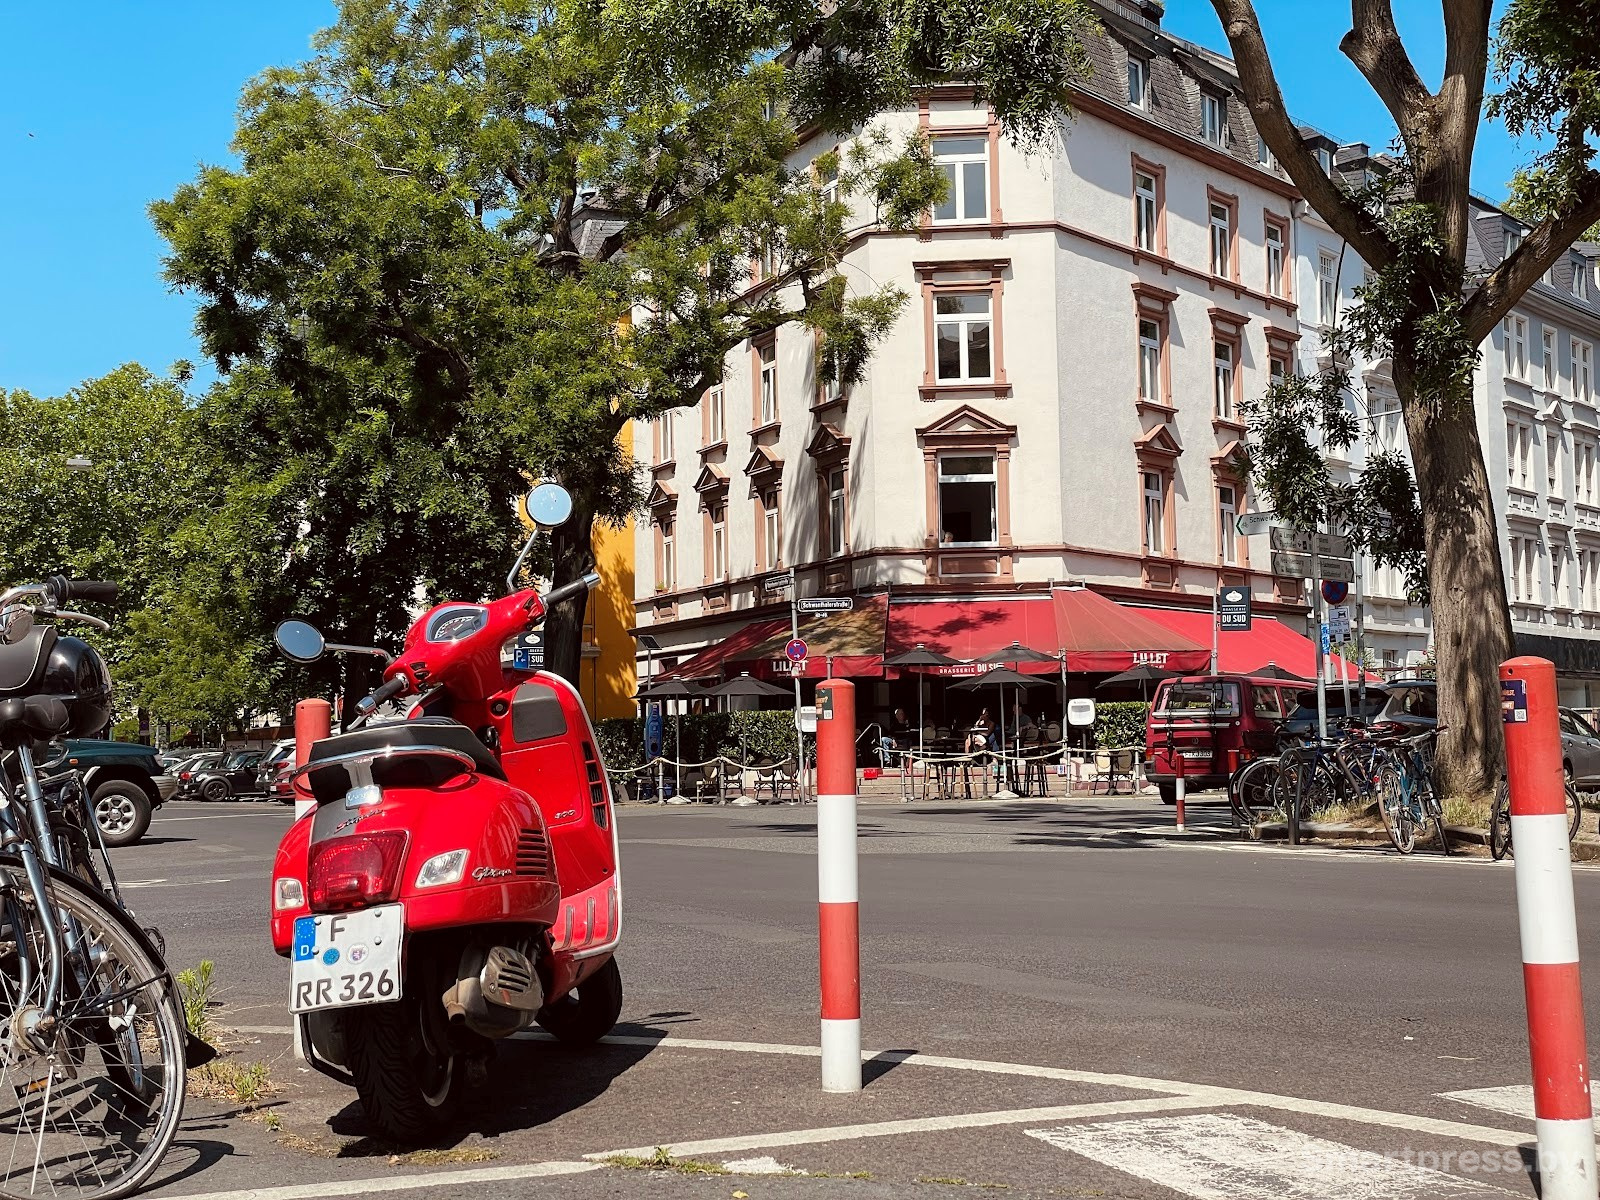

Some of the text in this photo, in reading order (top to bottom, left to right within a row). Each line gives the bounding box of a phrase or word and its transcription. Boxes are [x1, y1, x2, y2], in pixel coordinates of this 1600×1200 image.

[1222, 614, 1247, 623] DU SUD
[515, 650, 523, 662] P
[531, 655, 544, 663] SUD
[1132, 652, 1170, 664] LILLET
[977, 663, 987, 673] DU
[330, 914, 348, 942] F
[300, 945, 310, 957] D
[296, 969, 394, 1009] RR 326
